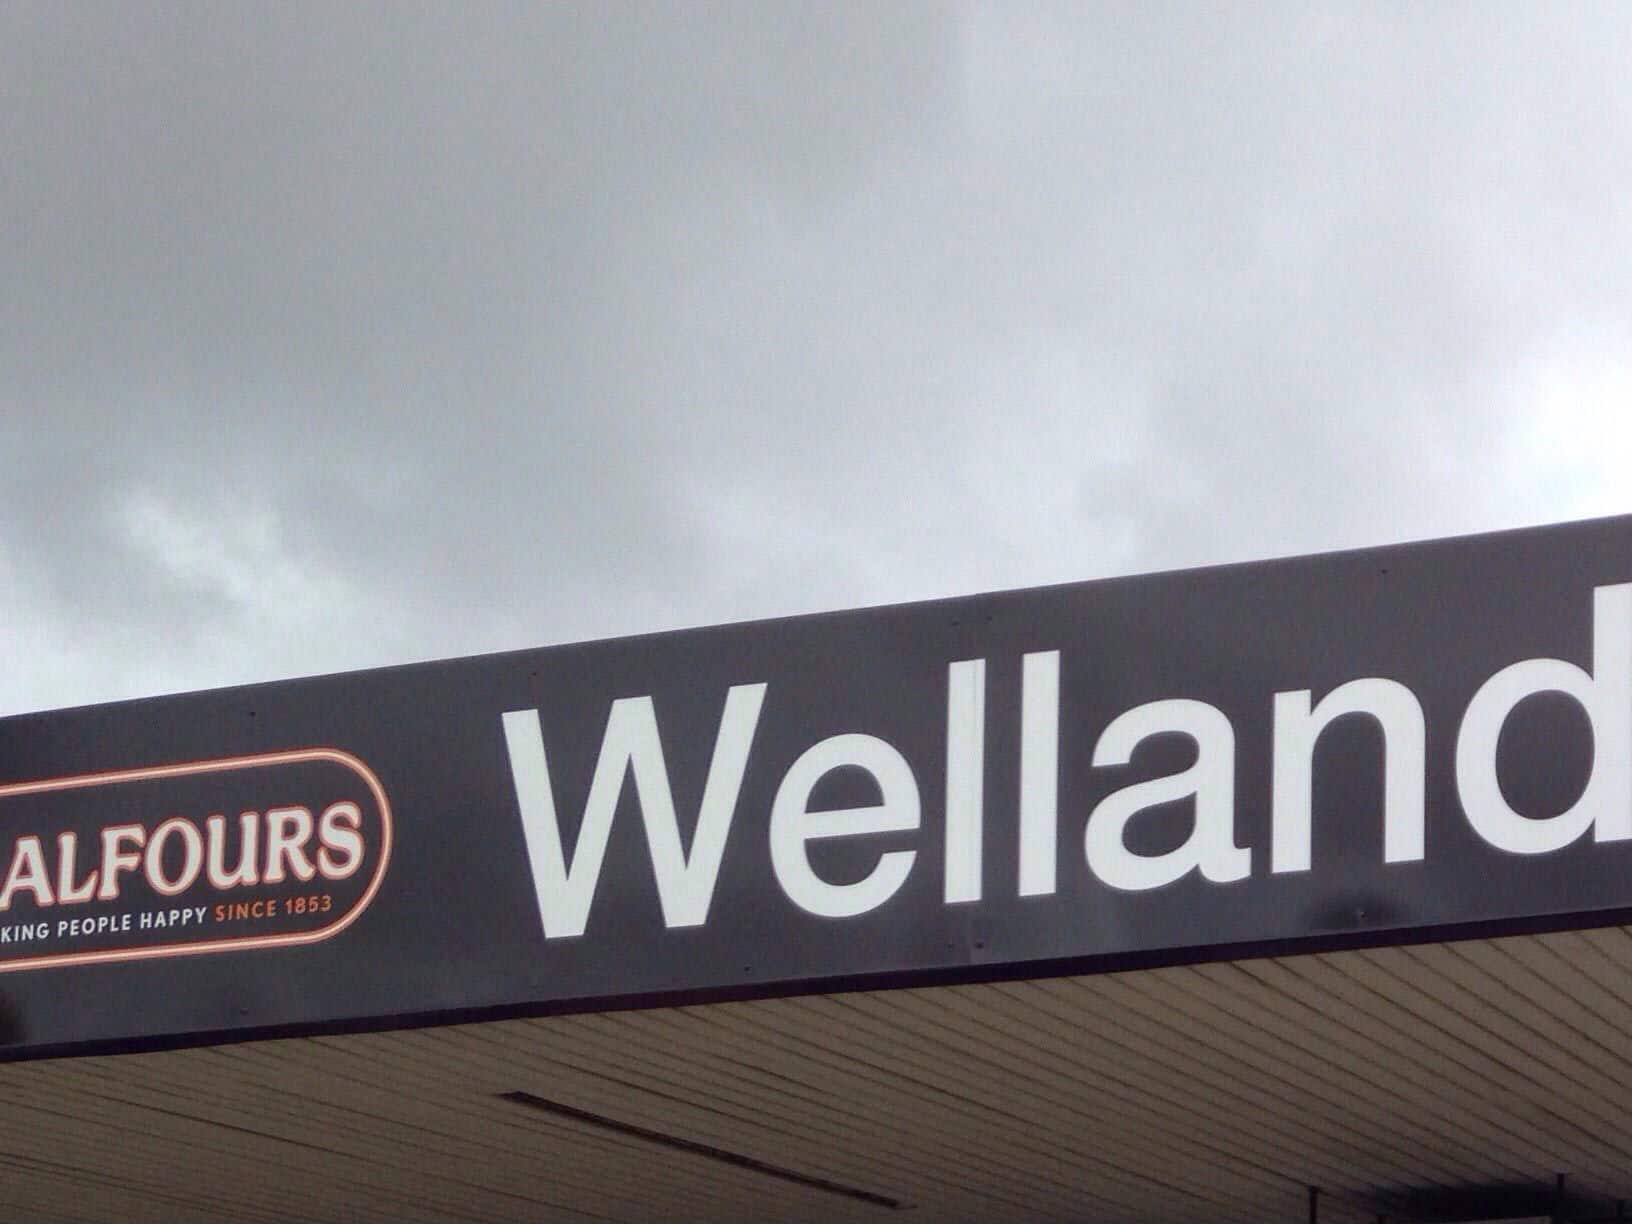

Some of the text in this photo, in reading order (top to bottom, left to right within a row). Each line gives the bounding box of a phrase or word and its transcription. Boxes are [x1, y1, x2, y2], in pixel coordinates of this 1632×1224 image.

[1, 923, 50, 943] KING
[58, 912, 132, 938] PEOPLE
[140, 906, 207, 930] HAPPY
[215, 899, 277, 923] SINCE
